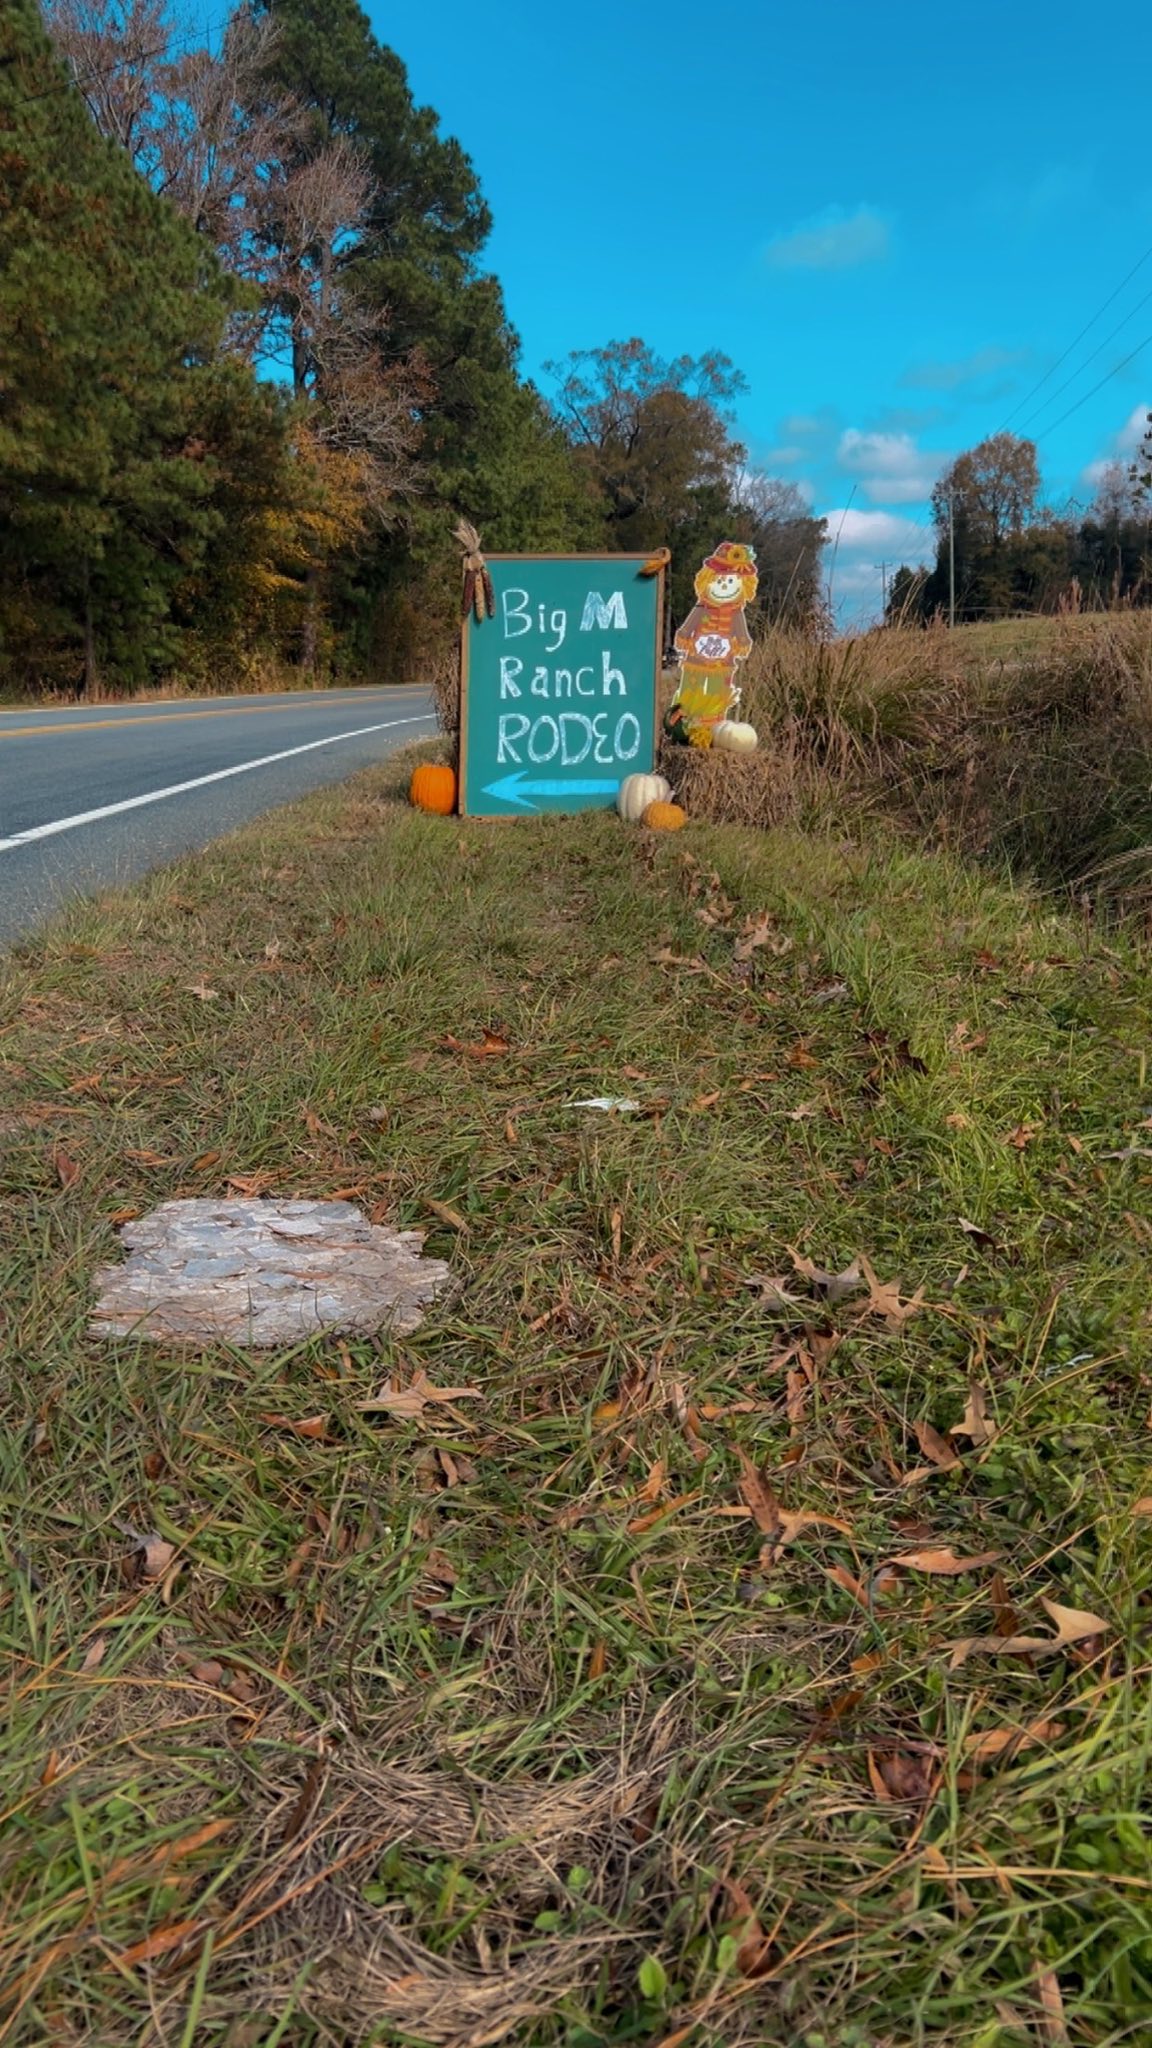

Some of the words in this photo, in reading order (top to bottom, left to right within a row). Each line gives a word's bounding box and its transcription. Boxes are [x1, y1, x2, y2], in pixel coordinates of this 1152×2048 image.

[502, 588, 567, 652] Big
[580, 591, 628, 631] M
[500, 651, 627, 699] Ranch
[497, 712, 641, 765] RODEO
